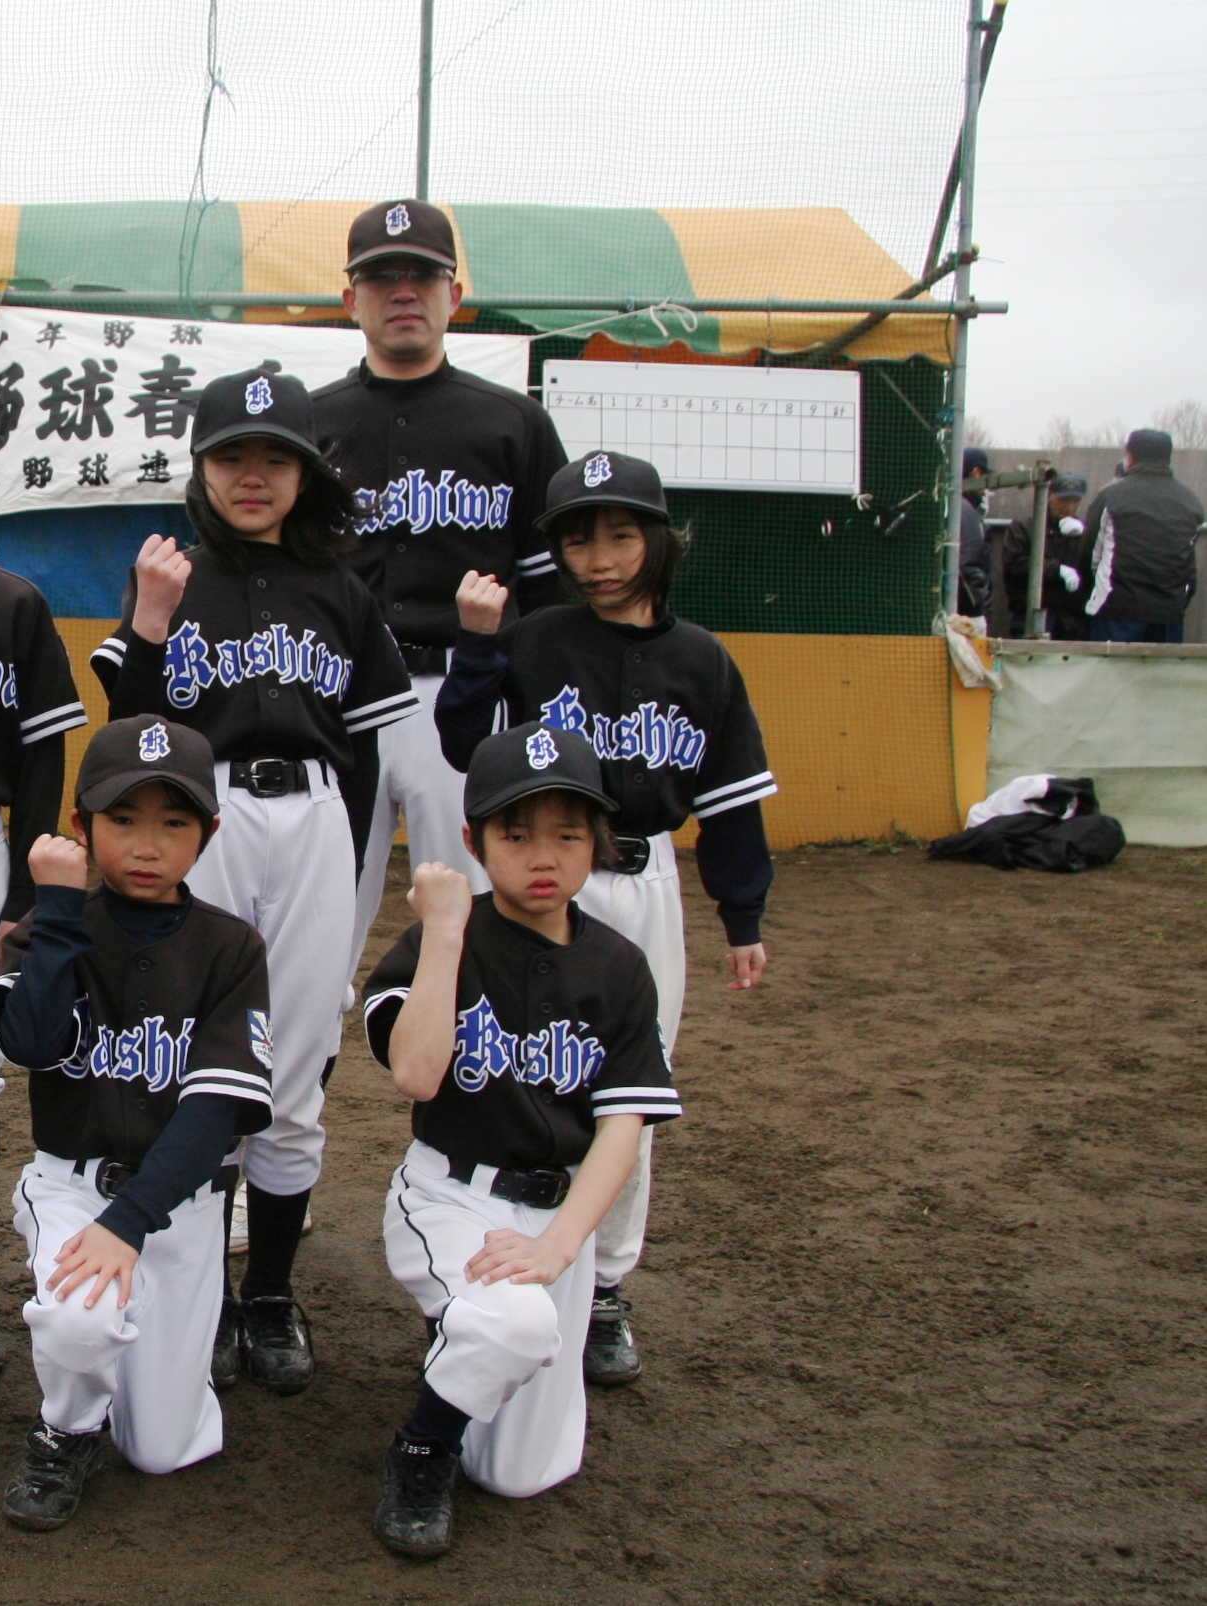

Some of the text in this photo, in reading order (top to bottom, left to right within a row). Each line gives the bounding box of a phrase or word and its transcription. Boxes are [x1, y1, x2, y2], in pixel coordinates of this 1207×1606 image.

[635, 396, 643, 407] 2
[661, 397, 669, 408] 3
[685, 398, 695, 409] 4
[711, 400, 720, 411] 5
[735, 402, 744, 412] 6
[759, 402, 768, 413] 7
[785, 403, 794, 414] 8
[810, 404, 817, 416] 9
[331, 468, 513, 535] ashiwa
